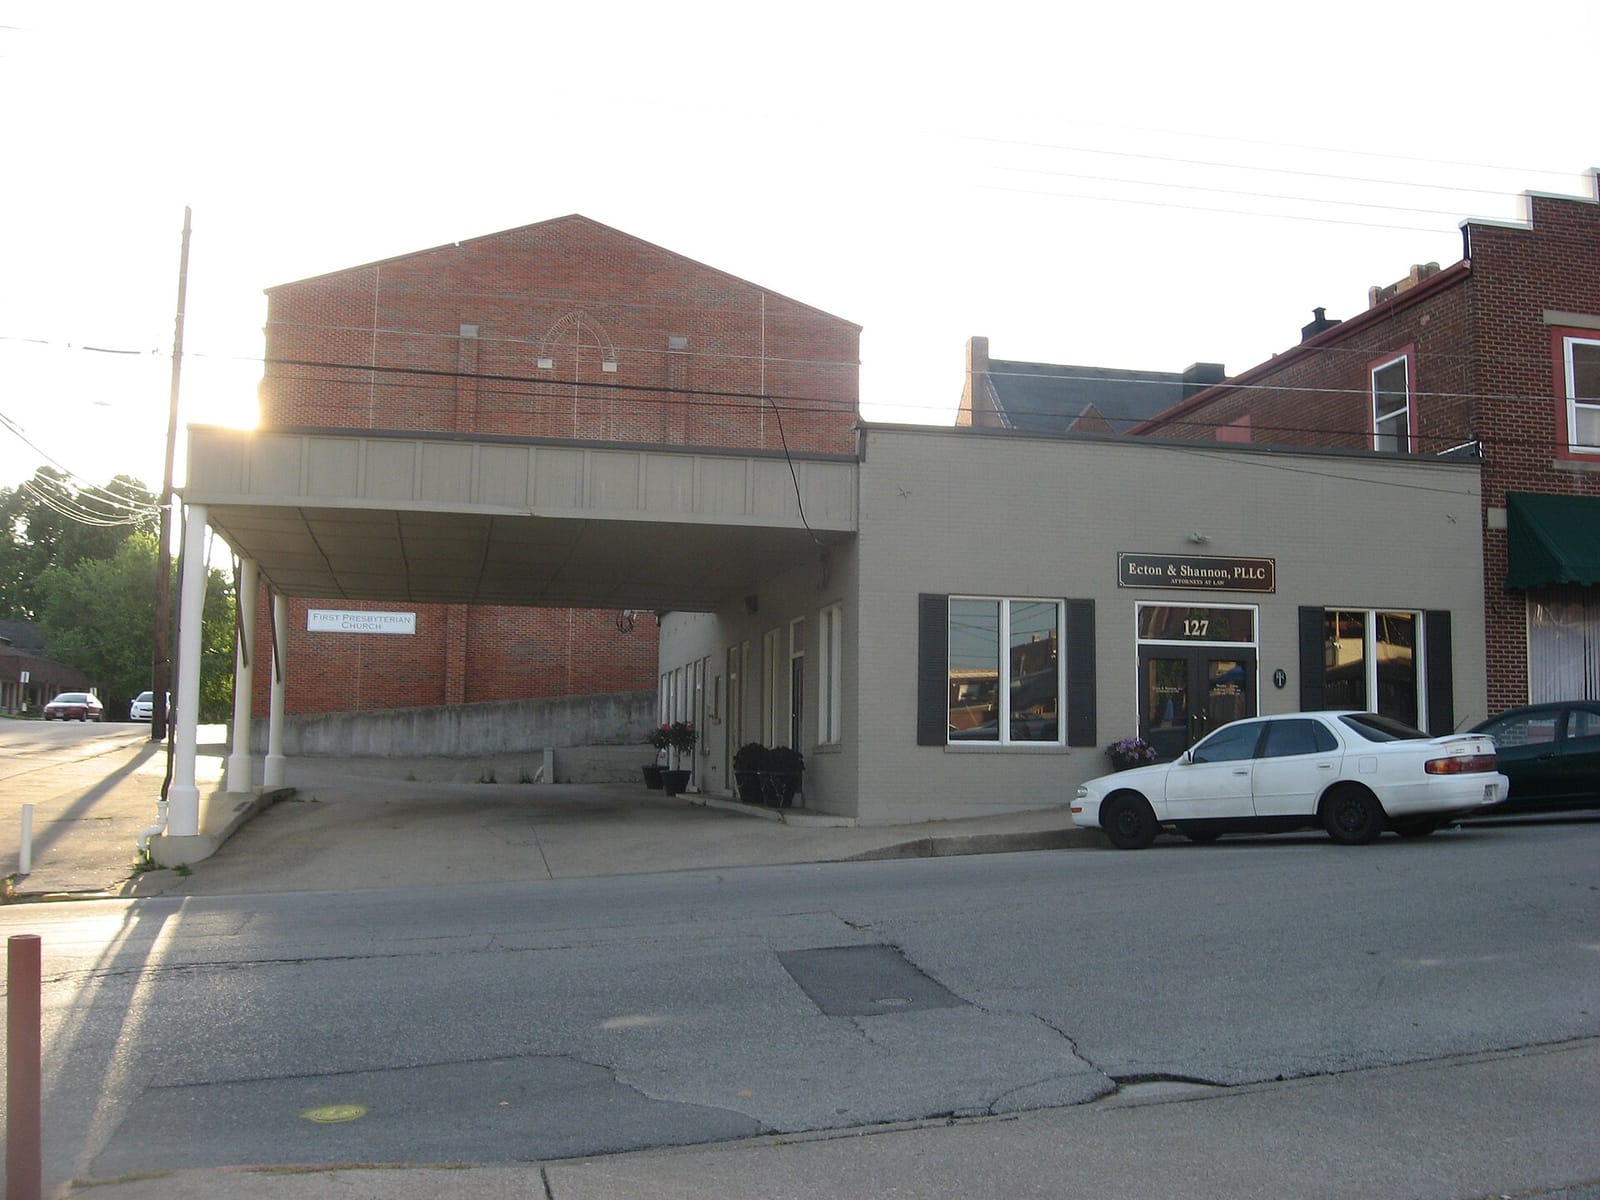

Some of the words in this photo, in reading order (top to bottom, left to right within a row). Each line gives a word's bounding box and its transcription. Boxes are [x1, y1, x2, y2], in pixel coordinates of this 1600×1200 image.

[1128, 562, 1162, 576] Ecton
[1167, 564, 1177, 576] &
[1180, 564, 1231, 579] Shannon,
[1234, 567, 1265, 579] PLLC
[313, 613, 340, 621] FIRST
[342, 614, 411, 623] PRESBYTERIAN
[341, 622, 382, 630] CHURCH
[1183, 619, 1209, 636] 127
